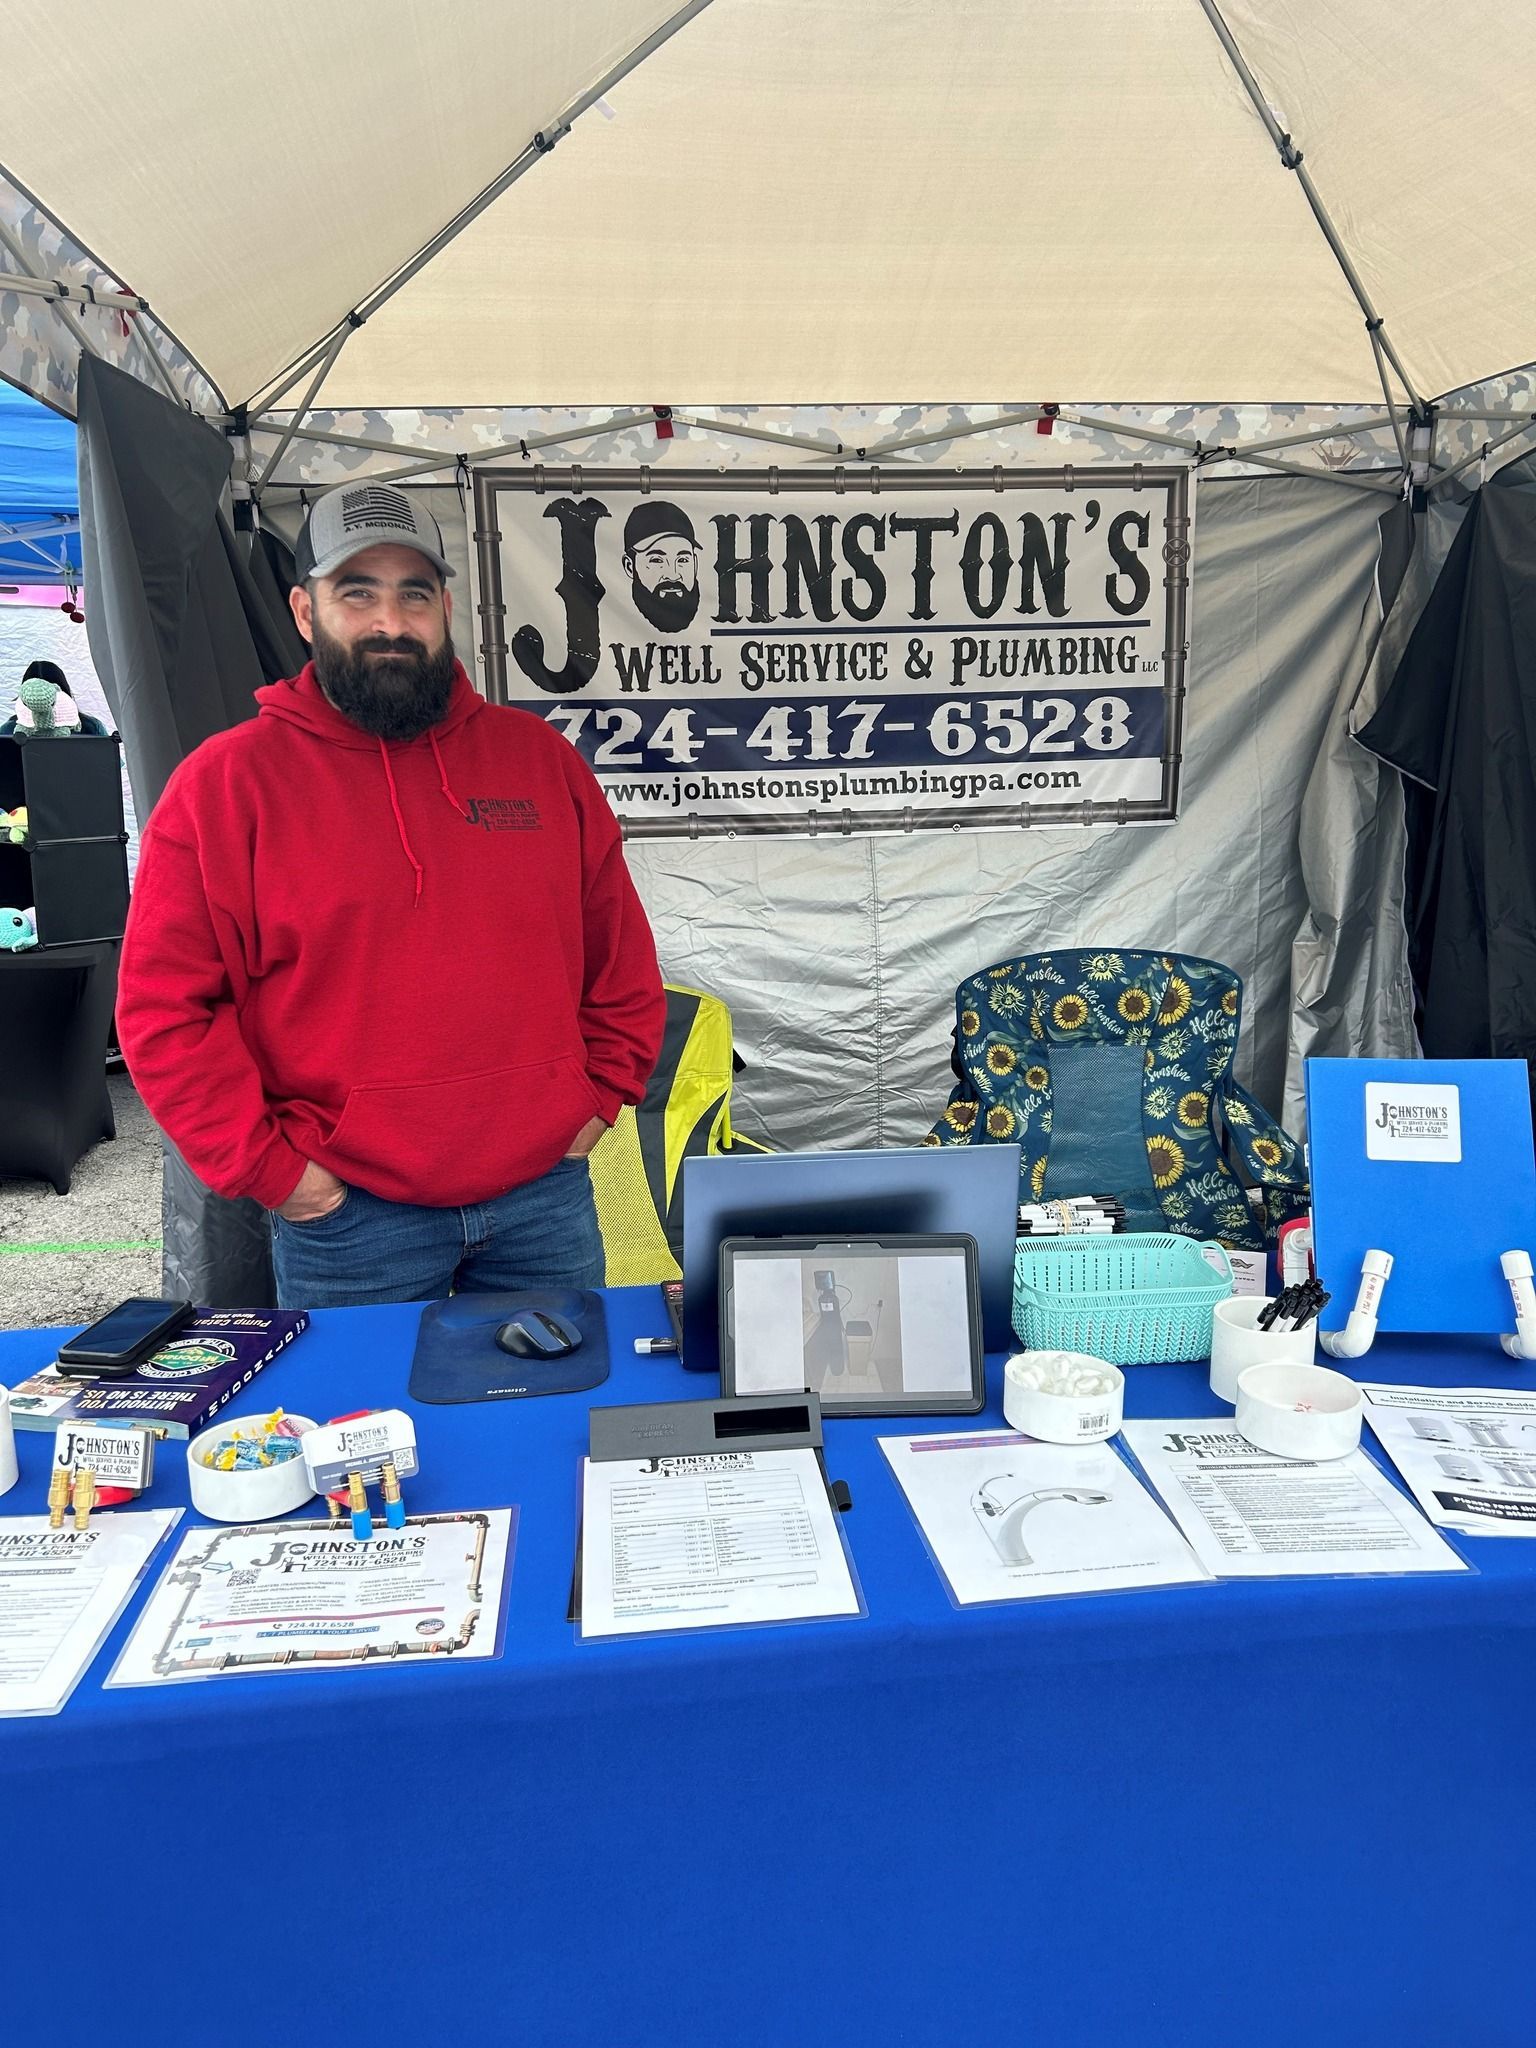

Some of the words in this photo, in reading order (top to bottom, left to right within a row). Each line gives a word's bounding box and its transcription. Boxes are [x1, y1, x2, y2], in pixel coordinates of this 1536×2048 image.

[609, 642, 721, 692] WELL
[739, 640, 888, 691] SERVICE
[904, 638, 933, 680] &
[951, 636, 1139, 686] PLUMBING
[1142, 661, 1158, 672] LLC
[544, 696, 1135, 765] 724-417-6528
[1189, 1009, 1227, 1035] Hello
[1185, 1171, 1226, 1198] Hello
[233, 1318, 272, 1328] Pump
[83, 1389, 106, 1400] US.
[106, 1390, 130, 1401] NO
[131, 1390, 148, 1402] IS
[149, 1391, 198, 1402] THERE
[1389, 1395, 1445, 1404] Installation
[75, 1399, 109, 1411] YOU
[108, 1399, 178, 1411] WITHOUT
[1452, 1496, 1491, 1508] Please
[1493, 1503, 1520, 1511] read
[1466, 1503, 1504, 1515] before
[313, 1556, 407, 1567] 724-417-6528
[287, 1621, 355, 1629] 724.417.6528
